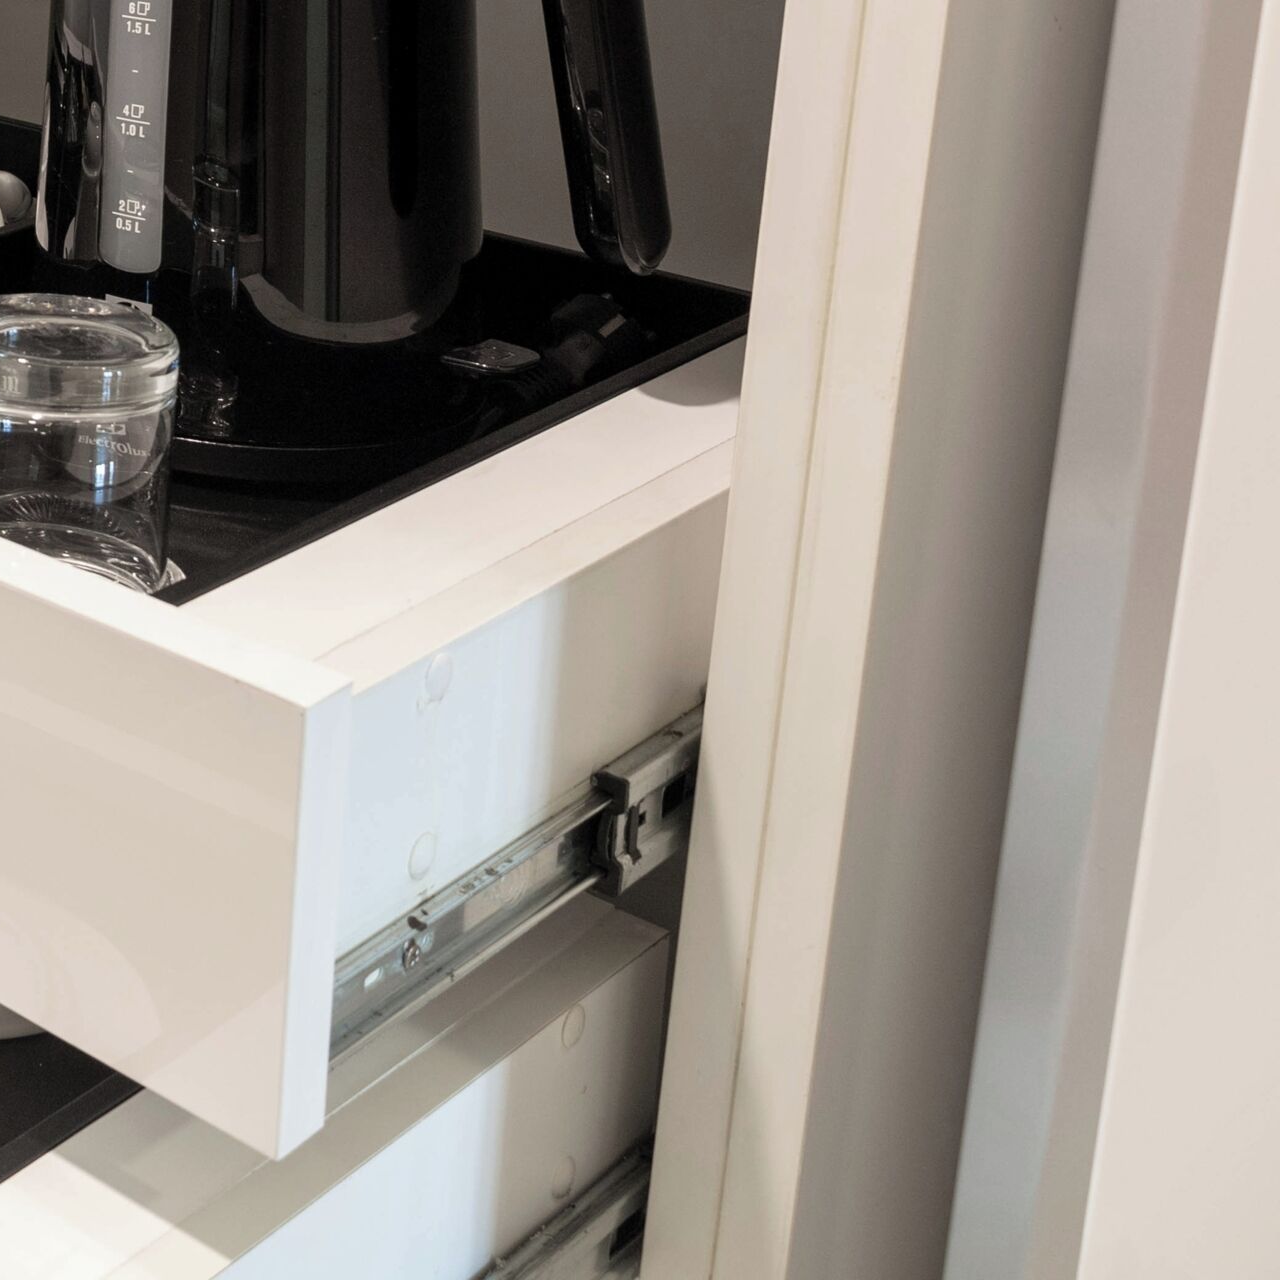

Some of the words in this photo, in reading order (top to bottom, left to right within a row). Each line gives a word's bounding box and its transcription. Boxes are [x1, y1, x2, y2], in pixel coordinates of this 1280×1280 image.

[128, 2, 136, 15] 6
[125, 20, 142, 34] 1.5
[143, 23, 151, 35] L
[122, 104, 130, 117] 4
[120, 122, 136, 136] 1.0
[138, 125, 145, 138] L
[118, 199, 126, 212] 2
[115, 218, 133, 232] 0.5
[134, 221, 141, 234] L
[78, 434, 151, 457] Electrolux
